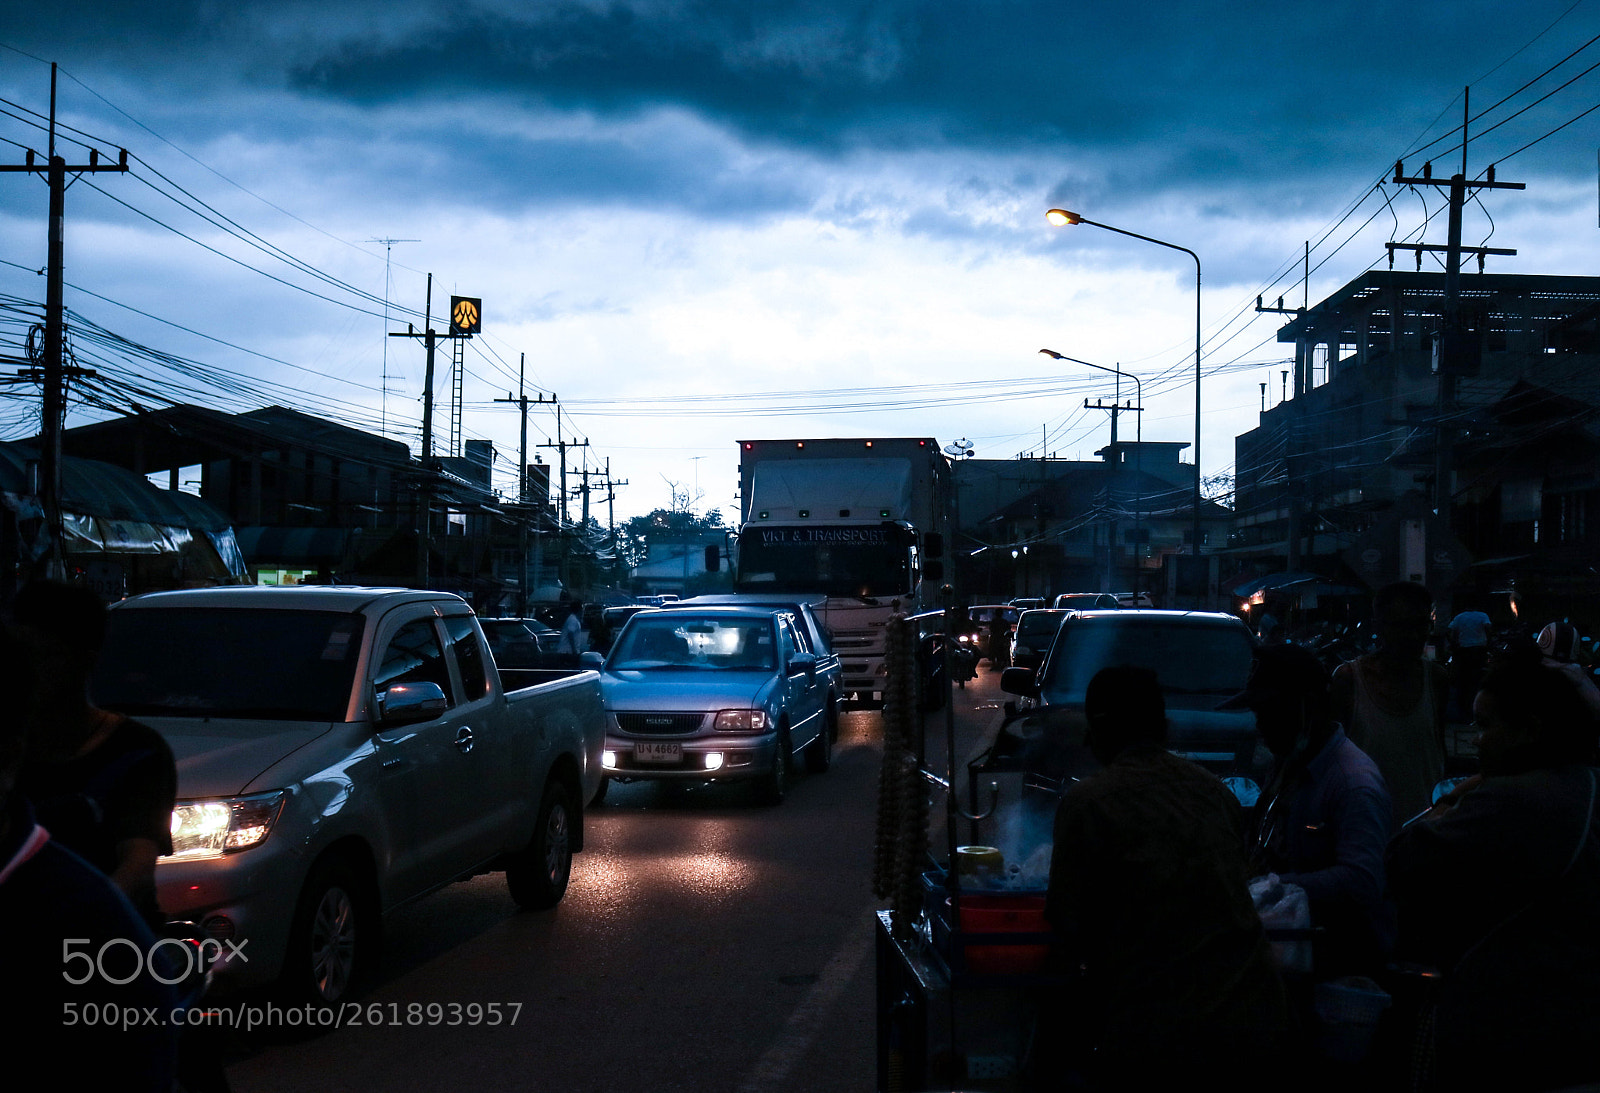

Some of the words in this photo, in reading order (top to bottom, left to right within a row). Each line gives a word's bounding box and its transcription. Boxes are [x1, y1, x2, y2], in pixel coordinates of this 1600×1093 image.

[762, 529, 787, 542] VKT
[792, 529, 801, 541] &
[807, 529, 888, 541] TRANSPORT
